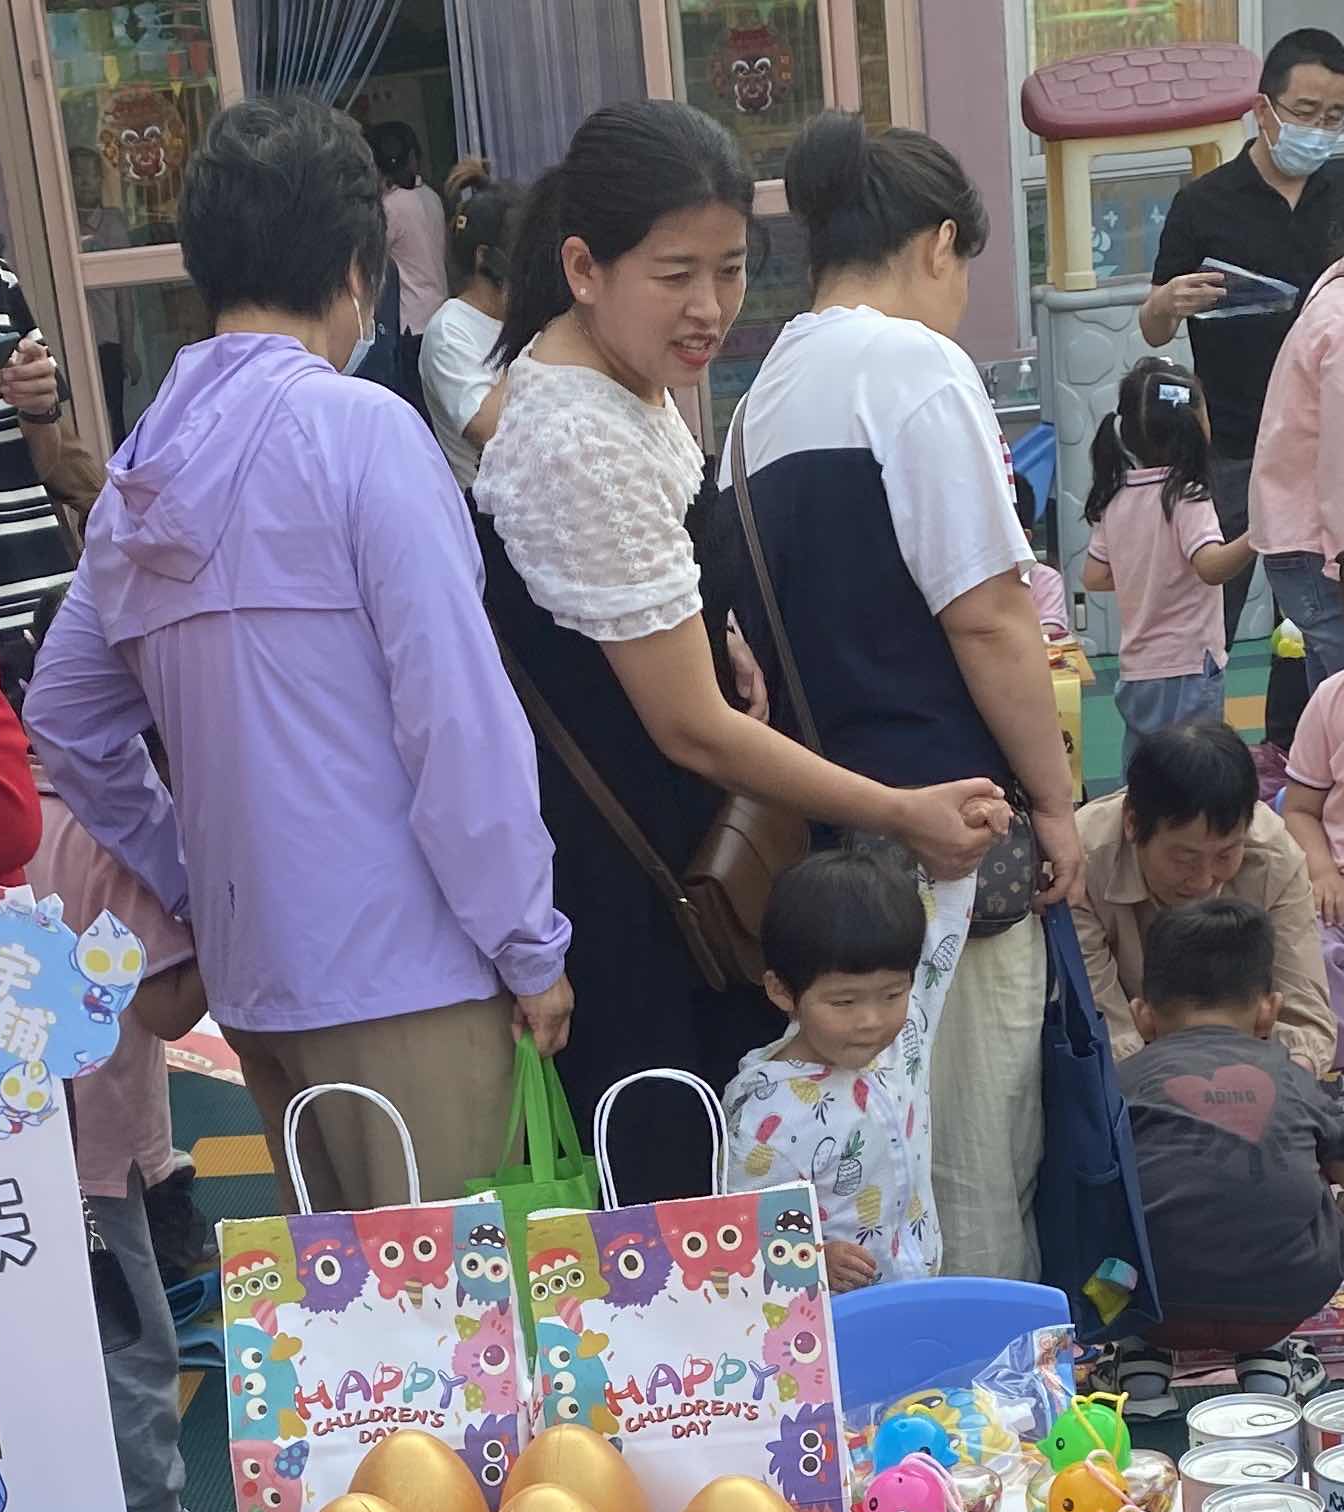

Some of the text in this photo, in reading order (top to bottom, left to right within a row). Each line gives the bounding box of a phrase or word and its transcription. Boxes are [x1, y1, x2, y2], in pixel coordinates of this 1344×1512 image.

[293, 1360, 467, 1421] HAPPY
[604, 1353, 780, 1417] HAPPY
[312, 1406, 445, 1435] CHILDREN'S
[624, 1400, 760, 1432] CHILDREN'S
[670, 1419, 713, 1440] DAY
[359, 1424, 399, 1444] DAY
